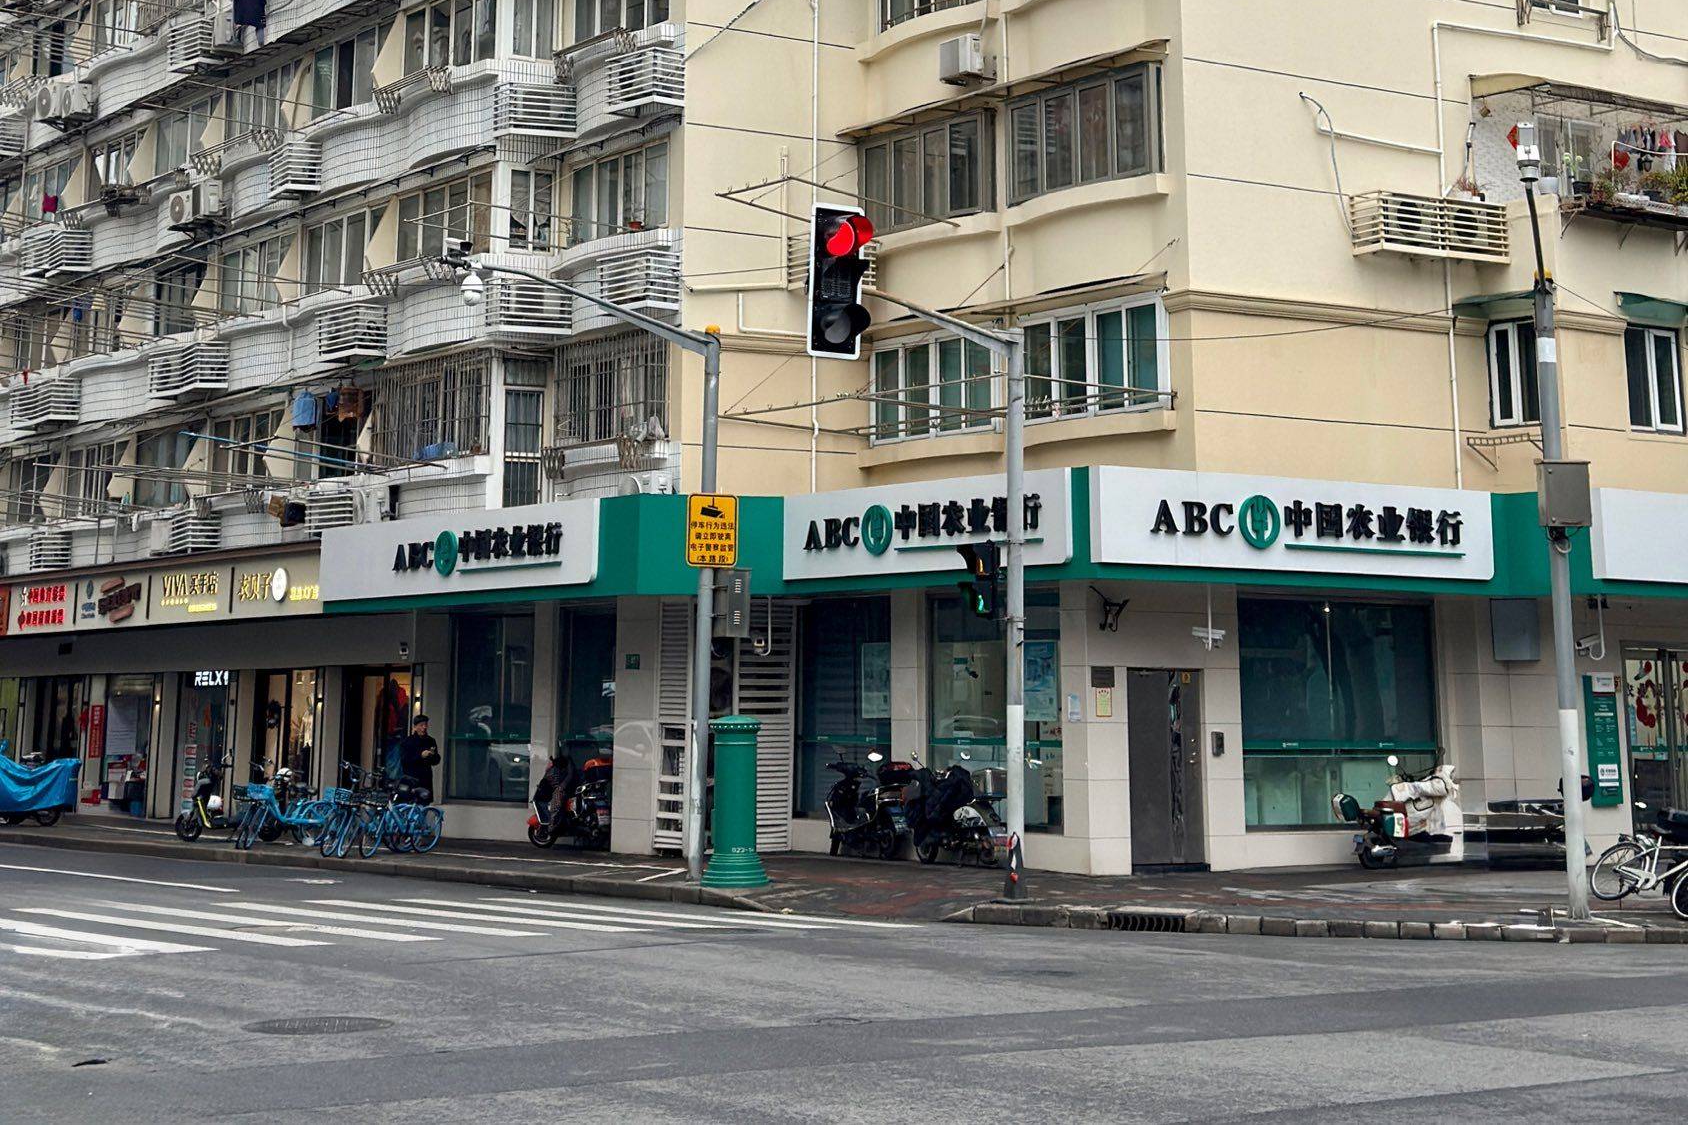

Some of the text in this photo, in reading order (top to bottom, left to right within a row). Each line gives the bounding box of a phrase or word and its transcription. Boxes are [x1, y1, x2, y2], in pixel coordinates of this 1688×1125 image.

[803, 493, 1042, 550] ABC 中国农业银行
[1150, 499, 1463, 546] ABC 中国农业银行
[392, 522, 563, 571] ABC 中国农业银行
[162, 573, 188, 597] VIVA
[194, 670, 224, 686] RELX
